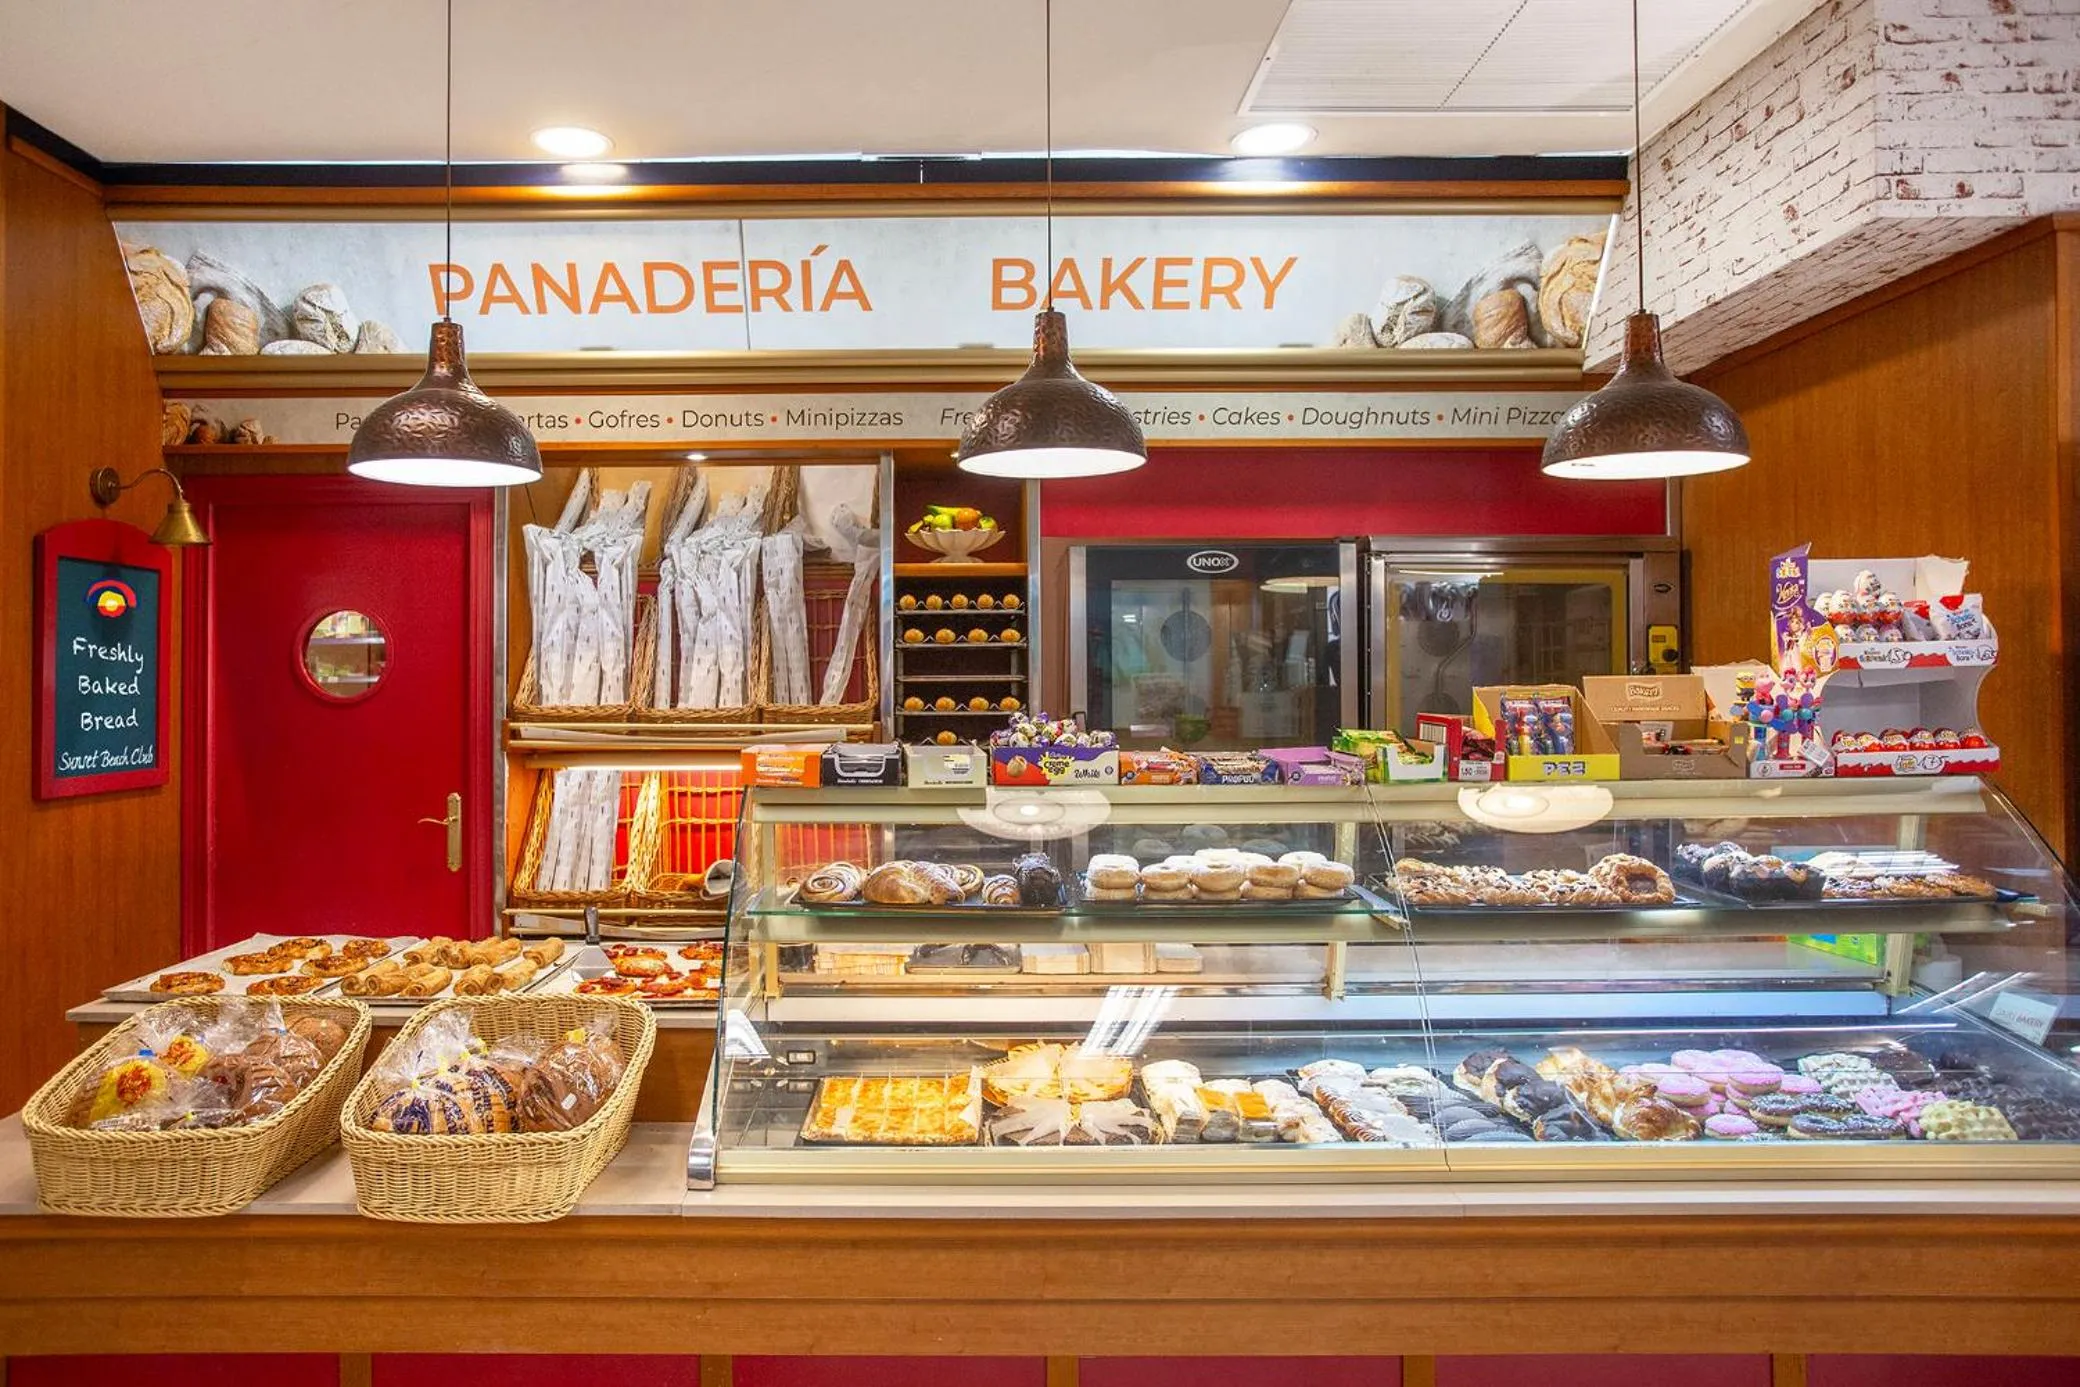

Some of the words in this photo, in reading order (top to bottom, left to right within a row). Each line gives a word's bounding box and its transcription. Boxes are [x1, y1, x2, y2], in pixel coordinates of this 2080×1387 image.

[429, 245, 873, 315] PANADERÍA
[991, 256, 1298, 311] BAKERY
[518, 413, 568, 429] rtas
[588, 409, 661, 430] Gofres
[682, 409, 765, 428] Donuts
[786, 408, 904, 431] Minipizzas
[1133, 406, 1192, 425] stries
[1212, 406, 1281, 426] Cakes
[1301, 406, 1431, 430] Doughnuts
[1451, 406, 1501, 426] Mini
[1506, 406, 1565, 425] Pizza
[72, 637, 144, 675] Freshly
[78, 675, 141, 697] Baked
[80, 708, 139, 732] Bread
[58, 750, 99, 771] Sunset
[100, 747, 129, 768] Beach
[130, 744, 154, 766] Club
